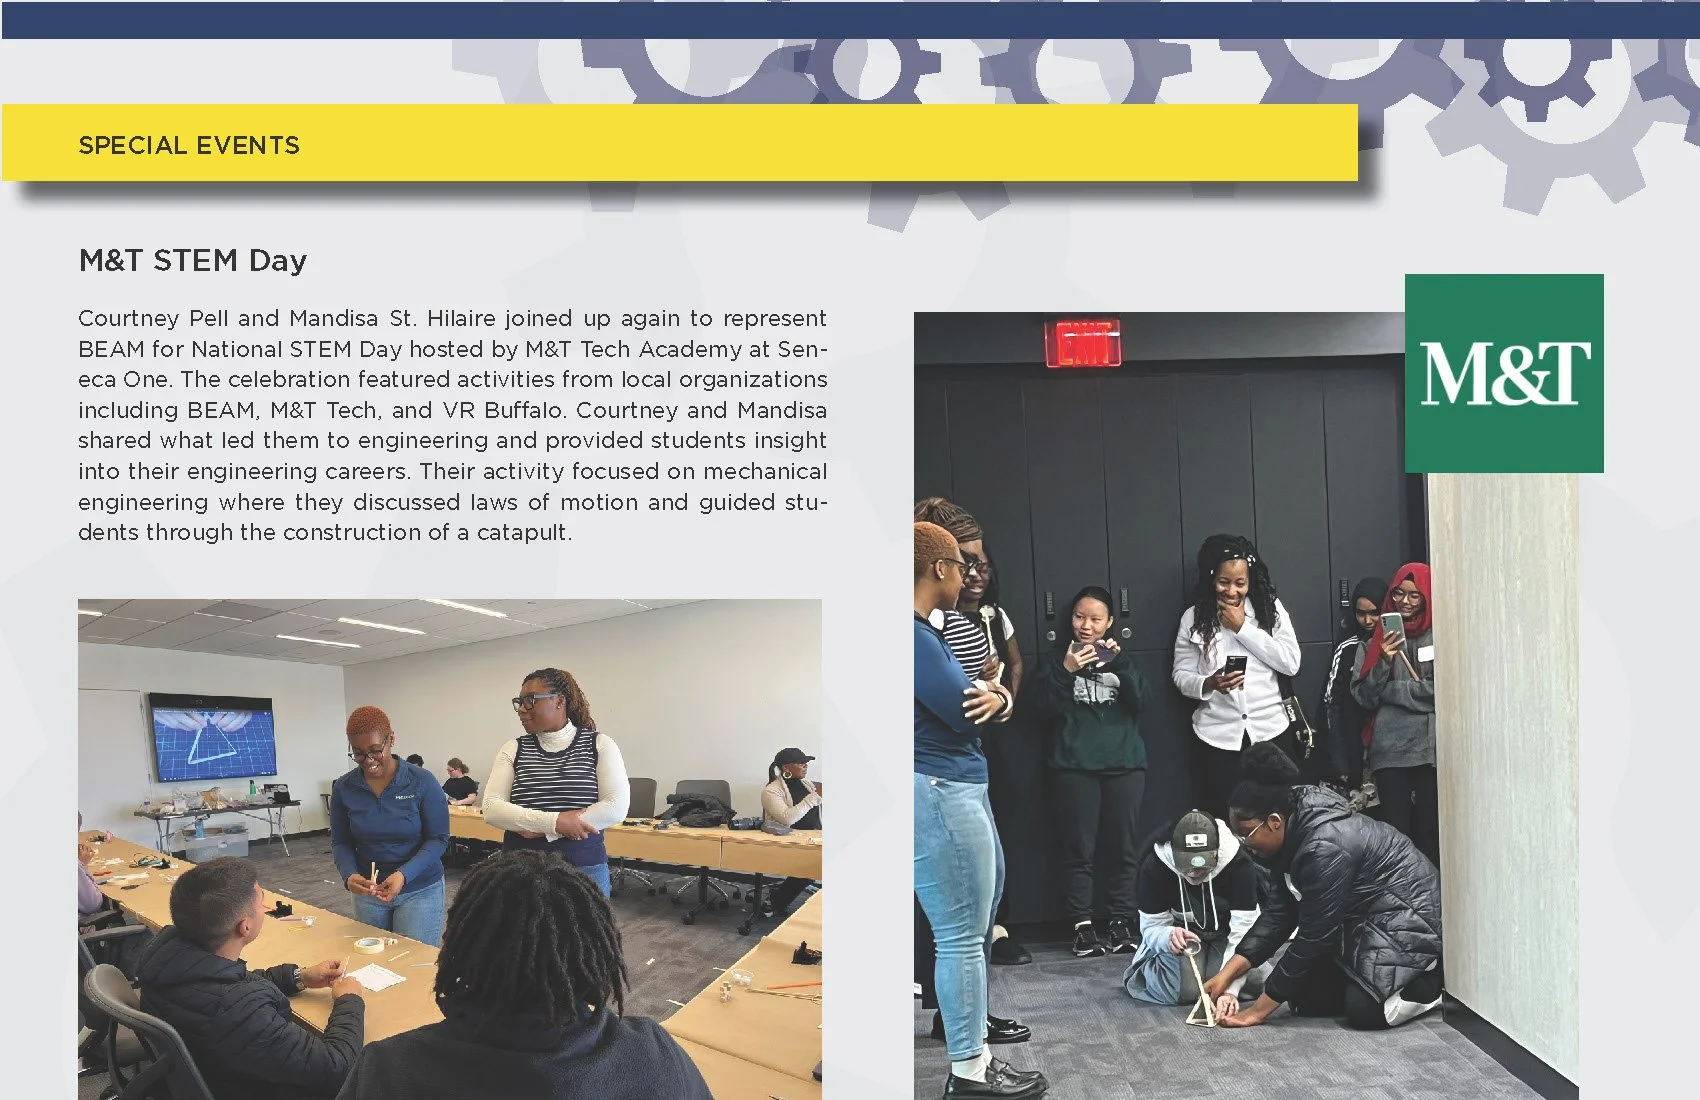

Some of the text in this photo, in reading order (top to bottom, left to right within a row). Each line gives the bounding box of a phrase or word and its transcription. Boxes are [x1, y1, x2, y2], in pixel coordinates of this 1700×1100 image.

[78, 135, 300, 155] SPECIAL EVENTS
[80, 248, 308, 277] M&T STEM Day
[78, 308, 827, 331] Courtney Pell and Mandisa St. Hilaire joined up again to represent
[79, 339, 828, 362] BEAM for National STEM Day hosted by M&T Tech Academy at Sen-
[78, 369, 828, 392] eca One. The celebration featured activities from local organizations
[1419, 341, 1593, 407] M&T
[79, 400, 827, 423] including BEAM, M&T Tech, and VR Buffalo. Courtney and Mandisa
[78, 522, 572, 545] dents through the construction of a catapult.
